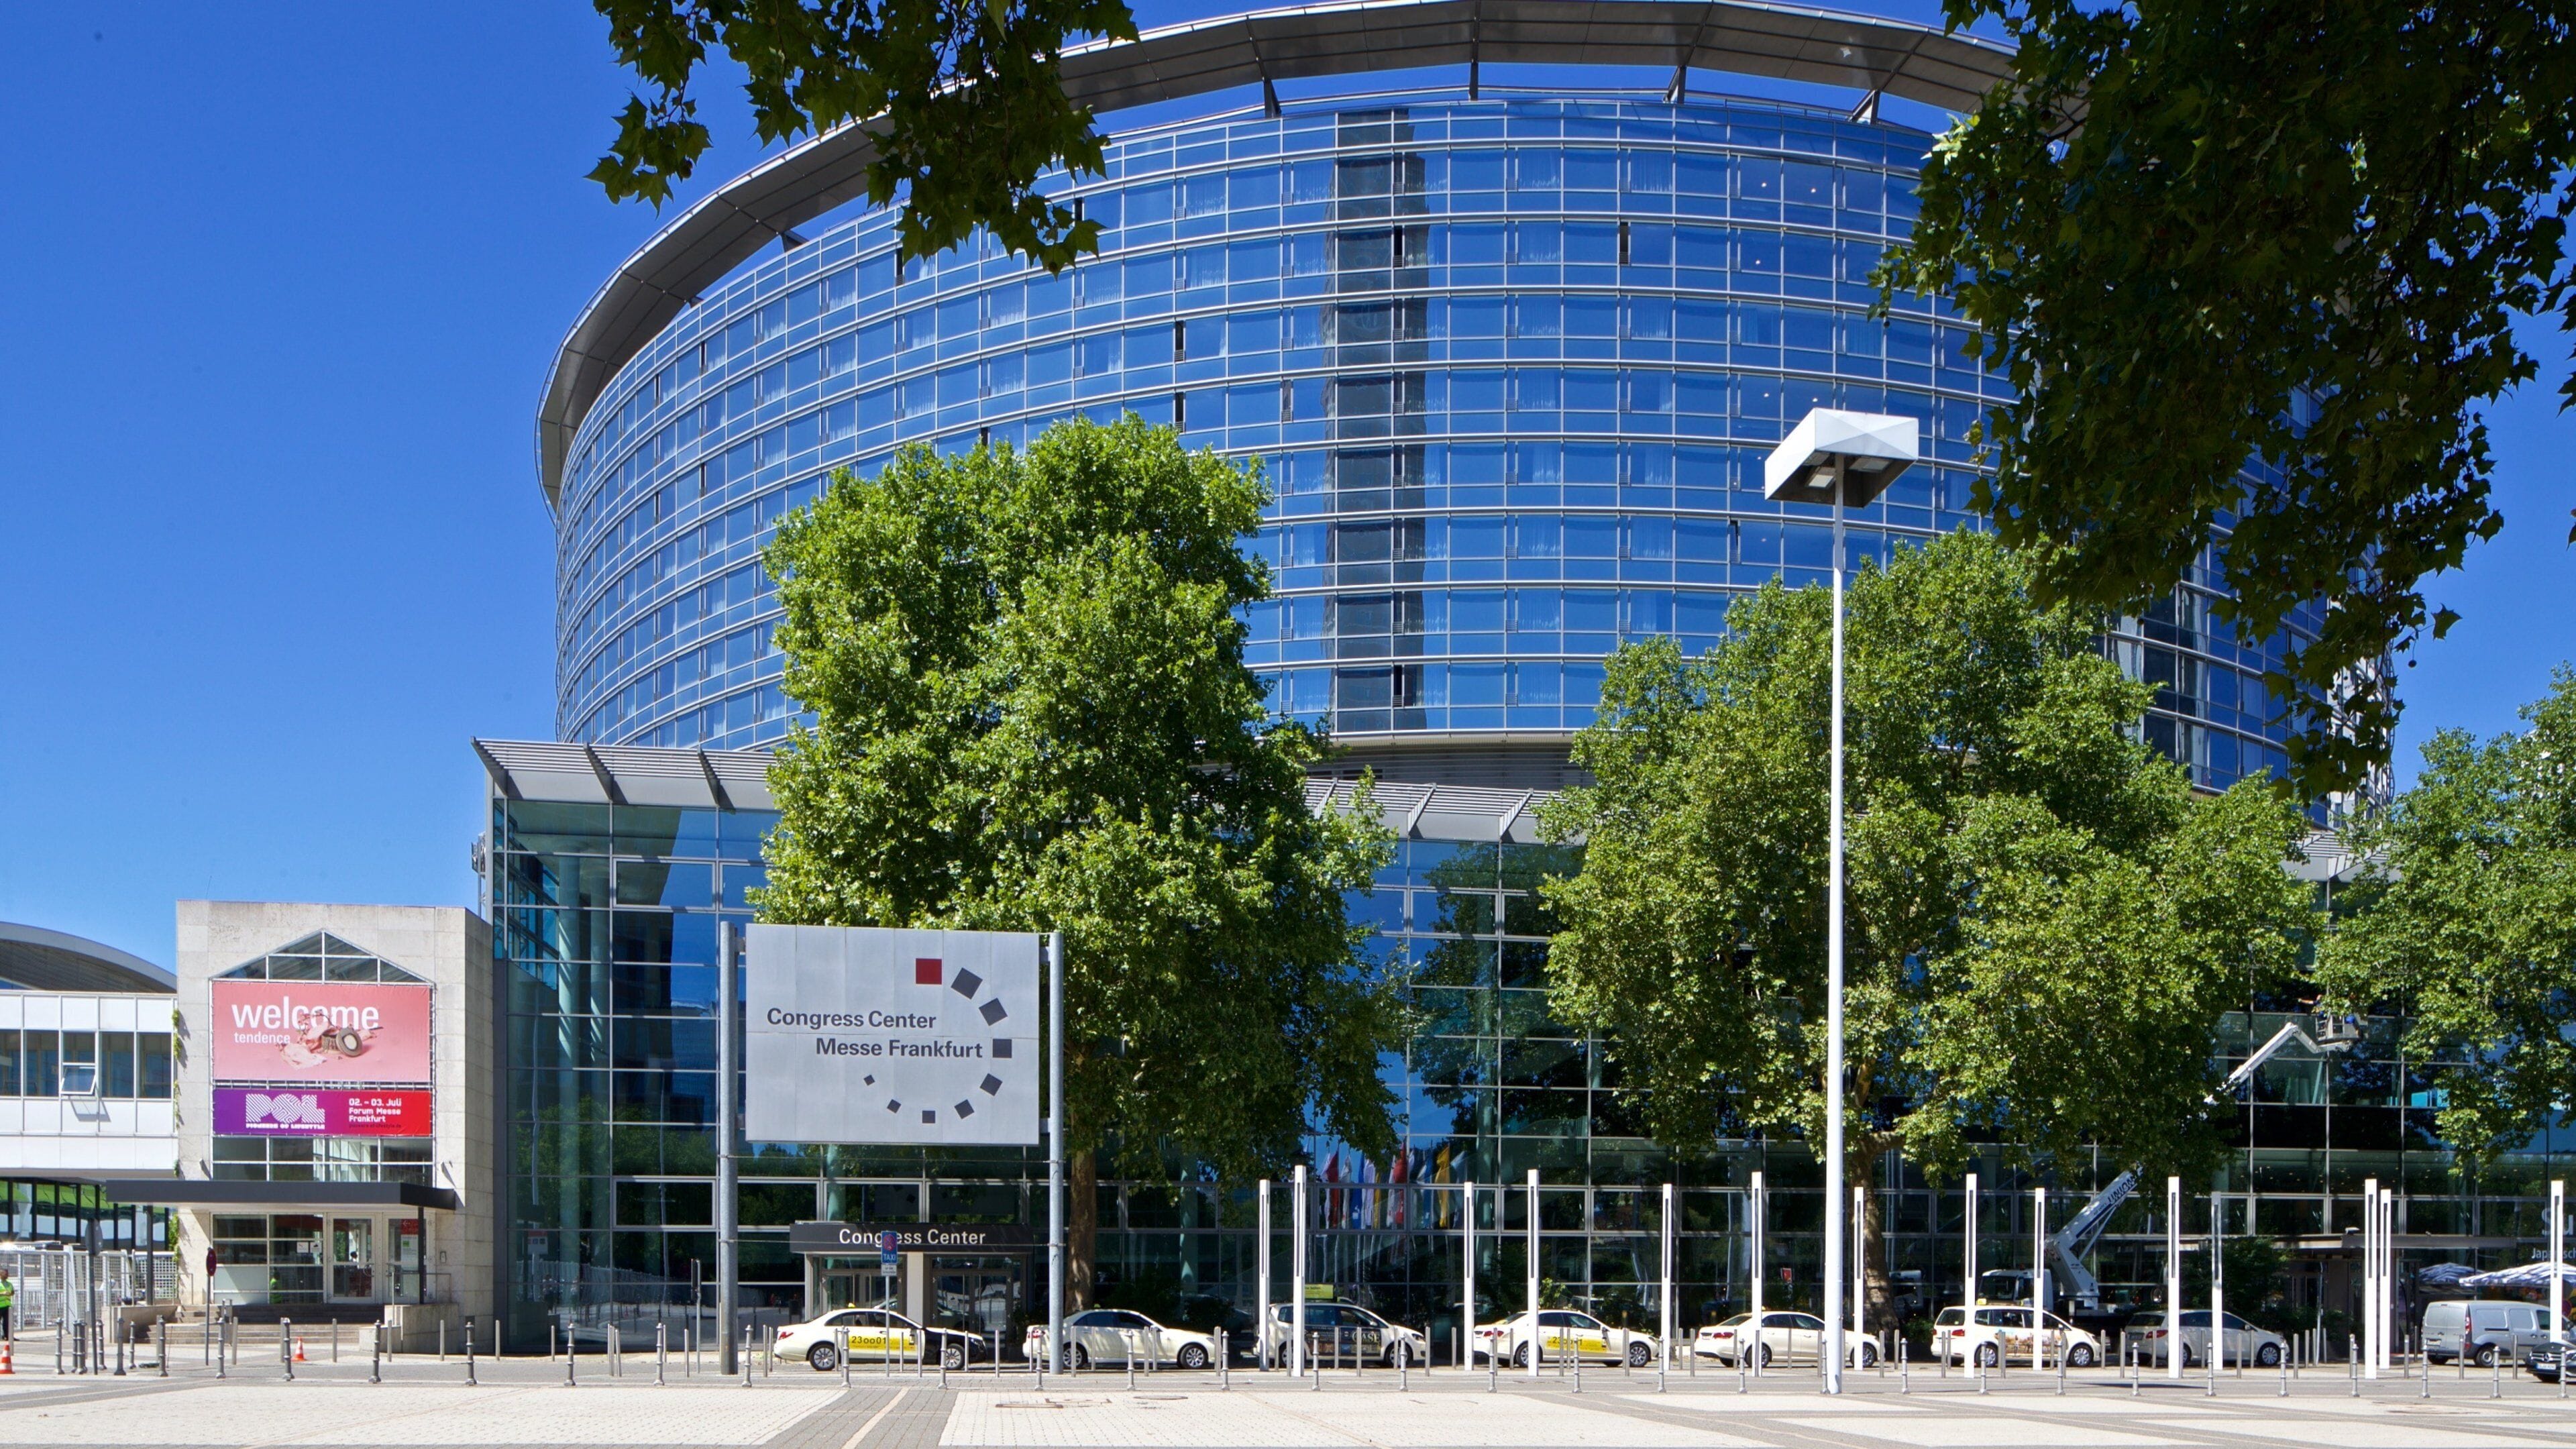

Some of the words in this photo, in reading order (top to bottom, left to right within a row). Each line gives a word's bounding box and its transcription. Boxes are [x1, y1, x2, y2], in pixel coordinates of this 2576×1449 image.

[231, 996, 379, 1030] welcome
[767, 1008, 864, 1030] Congress
[868, 1010, 936, 1028] Center
[234, 1032, 290, 1044] tendence
[816, 1038, 882, 1056] Messe
[889, 1040, 983, 1058] Frankfurt
[349, 1098, 362, 1106] 02.
[371, 1098, 384, 1106] 03.
[386, 1098, 402, 1106] Juli
[839, 1229, 922, 1247] Congess
[927, 1229, 986, 1244] Center
[883, 1253, 896, 1261] TAXI
